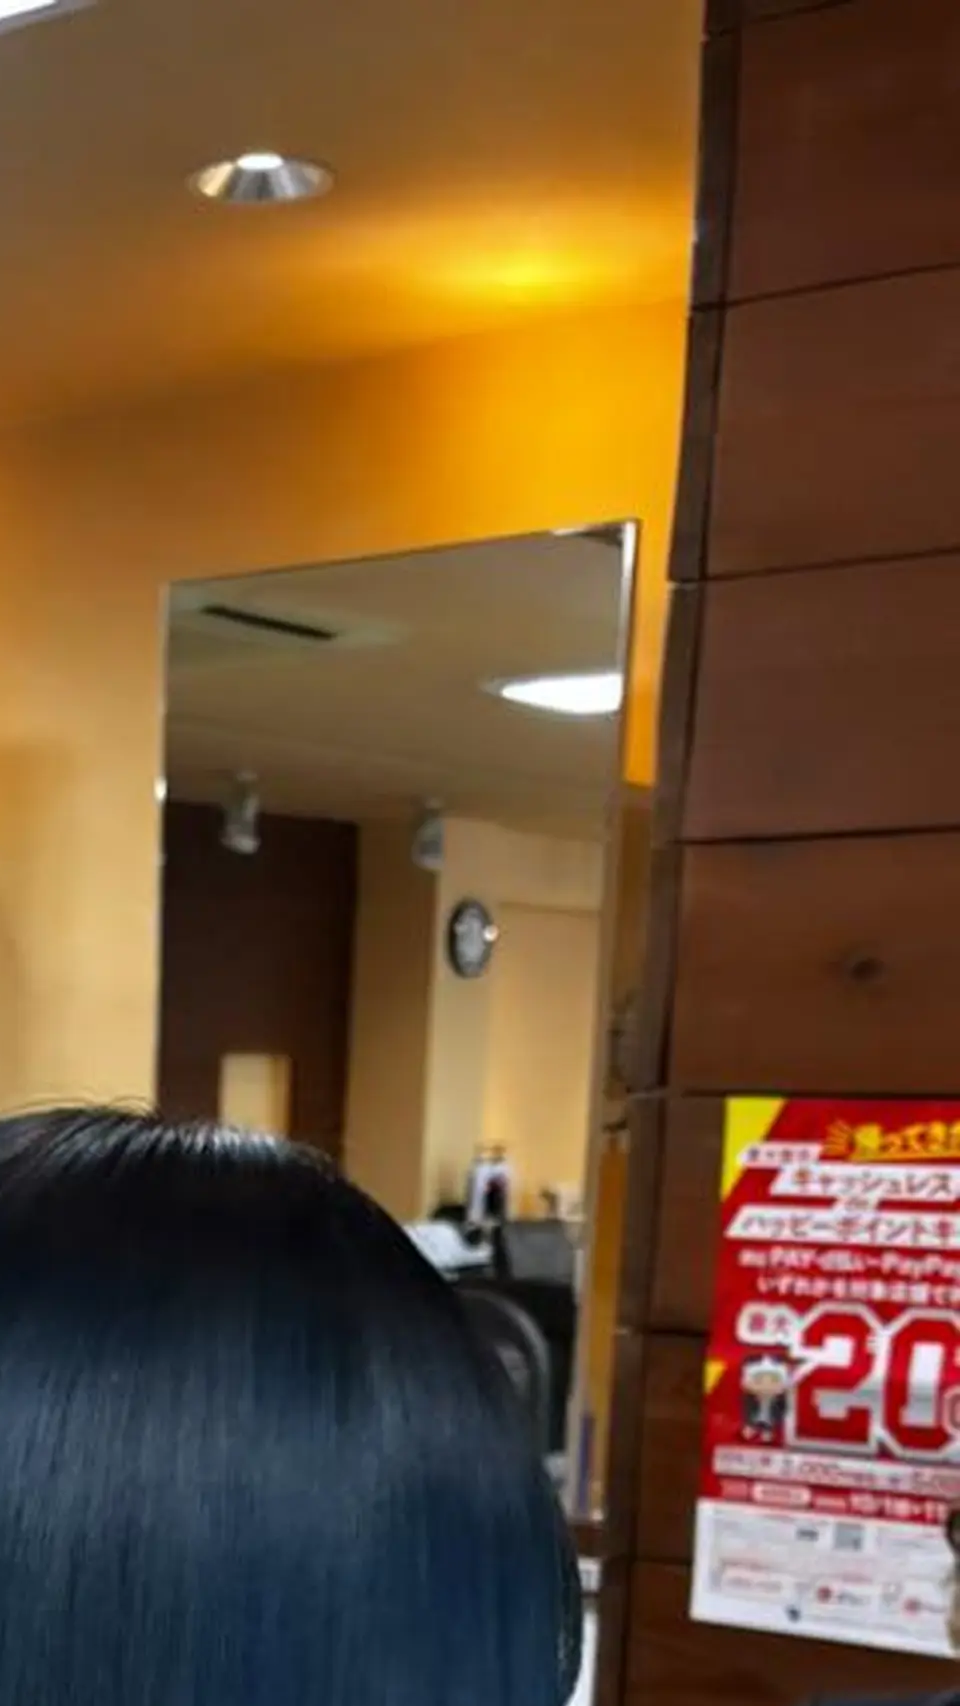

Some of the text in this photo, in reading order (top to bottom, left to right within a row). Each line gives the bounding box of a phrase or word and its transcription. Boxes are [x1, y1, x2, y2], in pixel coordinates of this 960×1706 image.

[793, 1169, 952, 1197] キャッシュレス
